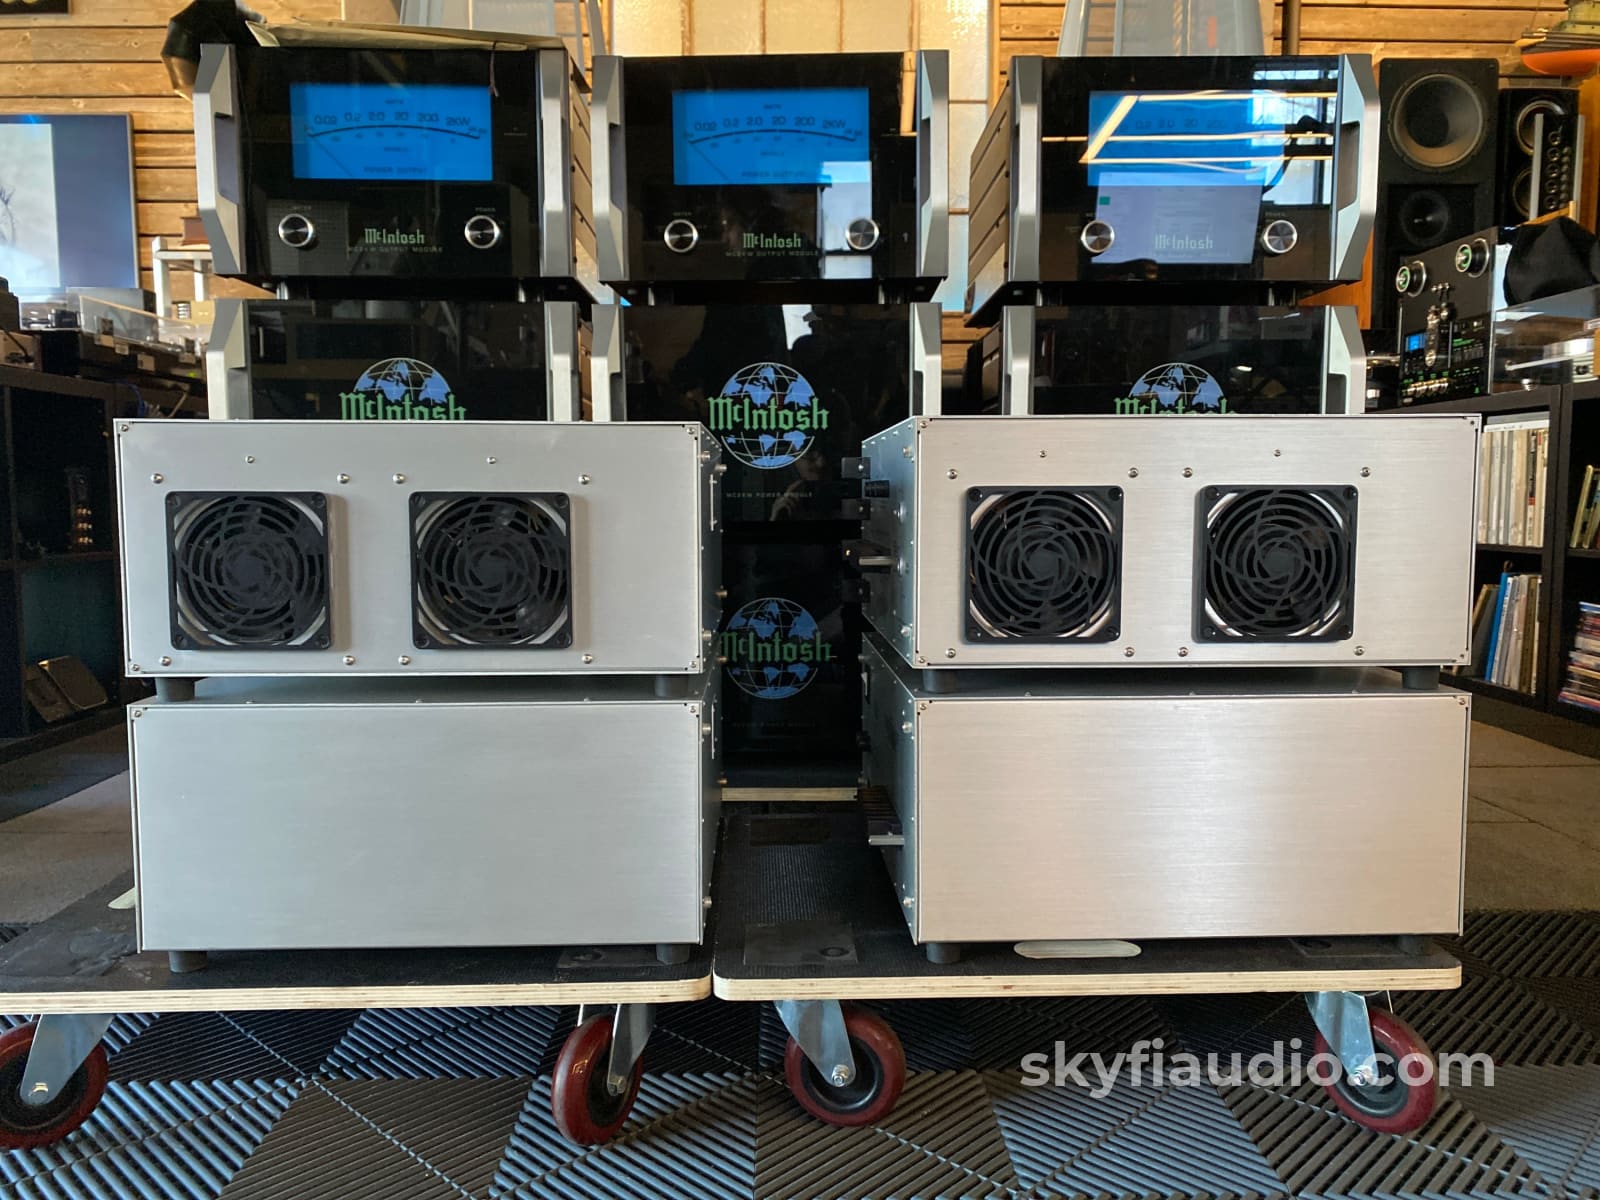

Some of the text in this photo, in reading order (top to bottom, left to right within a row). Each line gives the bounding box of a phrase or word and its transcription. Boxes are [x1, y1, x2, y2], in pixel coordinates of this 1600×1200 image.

[746, 117, 763, 127] 2.0
[772, 116, 786, 126] 20
[794, 117, 816, 127] 200
[364, 228, 425, 244] McIntosh
[743, 232, 801, 248] McIntosh
[1155, 234, 1214, 249] McIntosh
[338, 392, 467, 420] McIntosh
[707, 396, 829, 430] McIntosh
[720, 631, 832, 662] McIntosh
